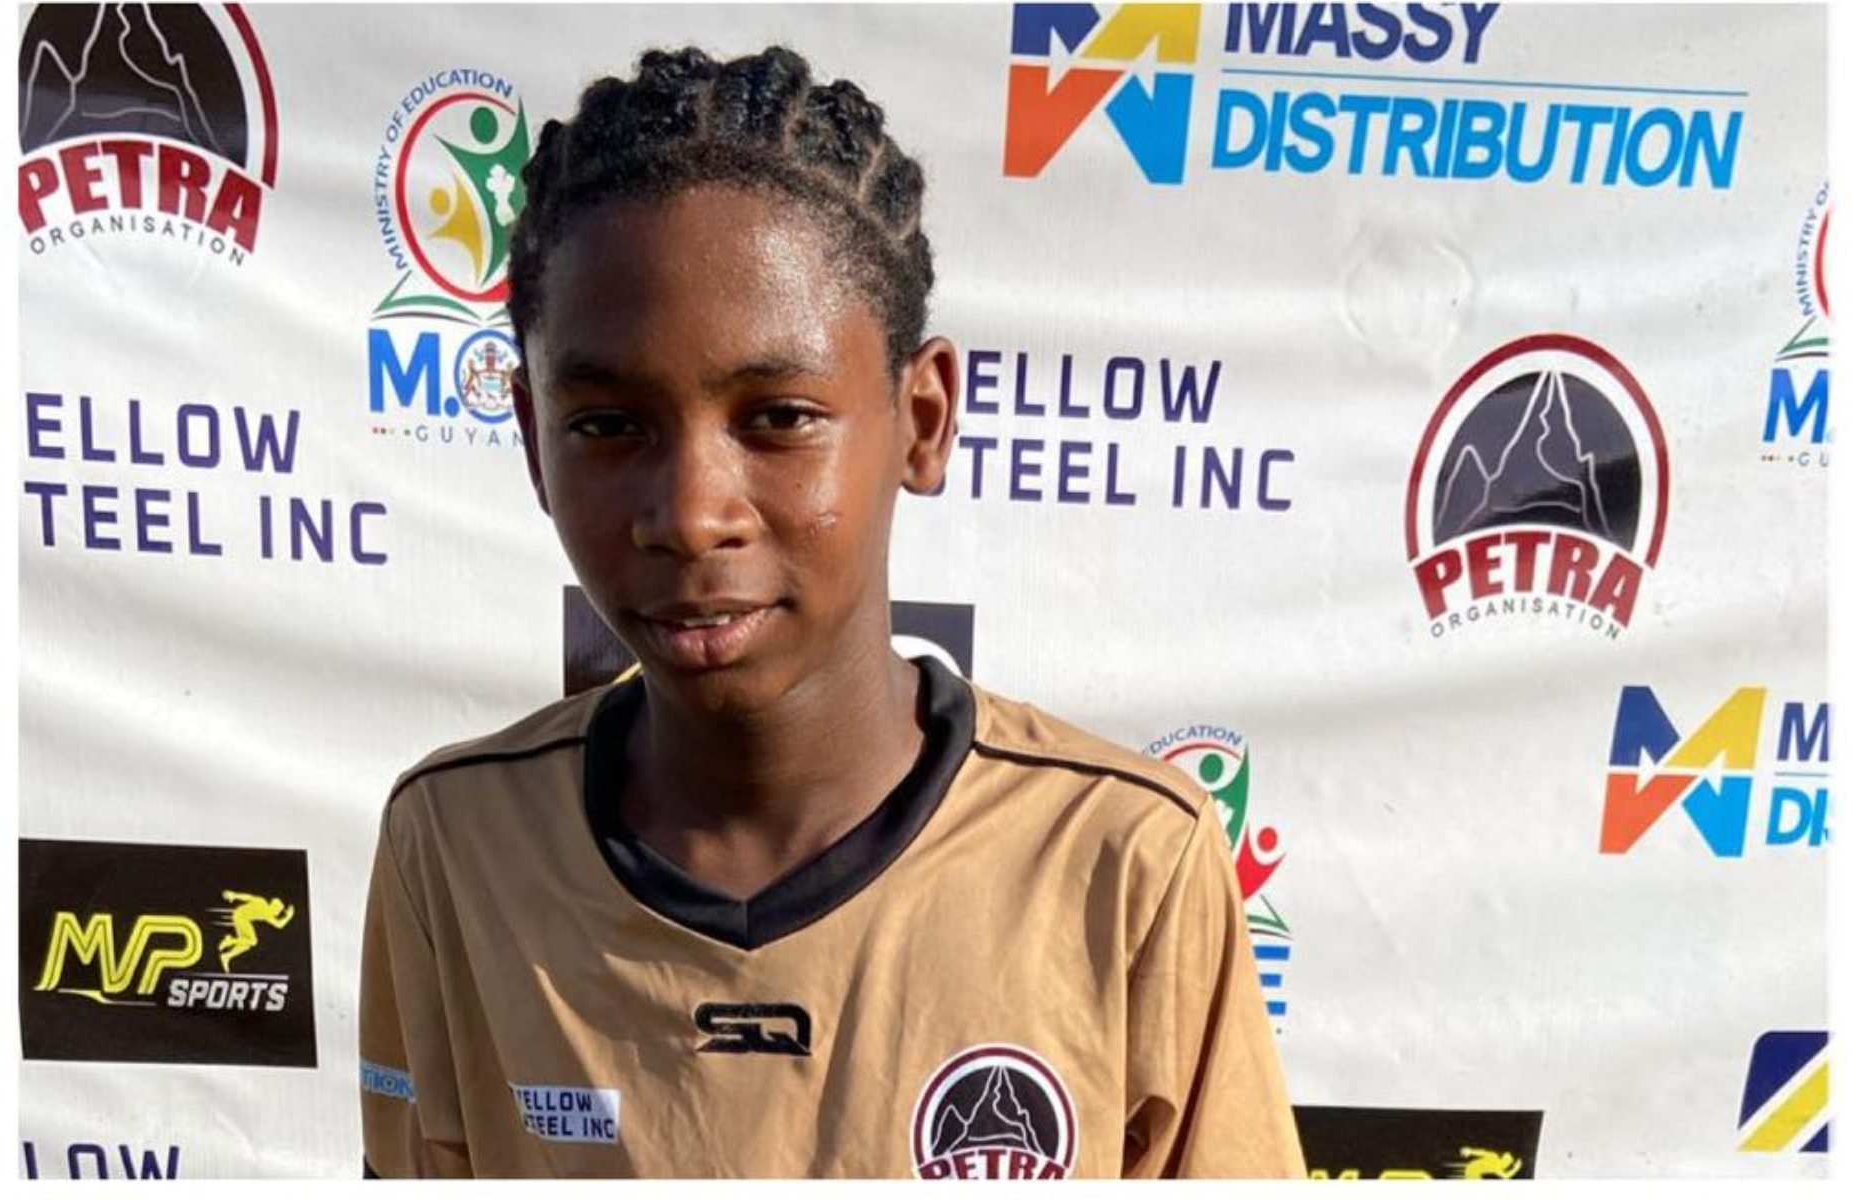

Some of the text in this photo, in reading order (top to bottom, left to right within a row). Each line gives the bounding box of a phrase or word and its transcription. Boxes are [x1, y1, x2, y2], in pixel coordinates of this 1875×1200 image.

[1226, 3, 1500, 64] MASSY
[376, 69, 515, 271] MINISTRY OF EDUCATION
[1212, 89, 1743, 189] DISTRIBUTION
[18, 140, 263, 254] PETRA
[31, 215, 245, 267] ORGANISATION
[966, 350, 1222, 420] ELLOW
[27, 393, 300, 473] ELLOW
[416, 425, 524, 448] GUYAN
[958, 435, 1295, 512] TEEL INC
[24, 481, 389, 566] TEEL INC
[1414, 530, 1644, 629] PETRA
[1430, 597, 1620, 641] ORGANISATION
[1149, 726, 1243, 756] DUCATION
[35, 911, 204, 996] MVP
[168, 977, 288, 1012] SPORTS
[584, 1117, 616, 1140] INC
